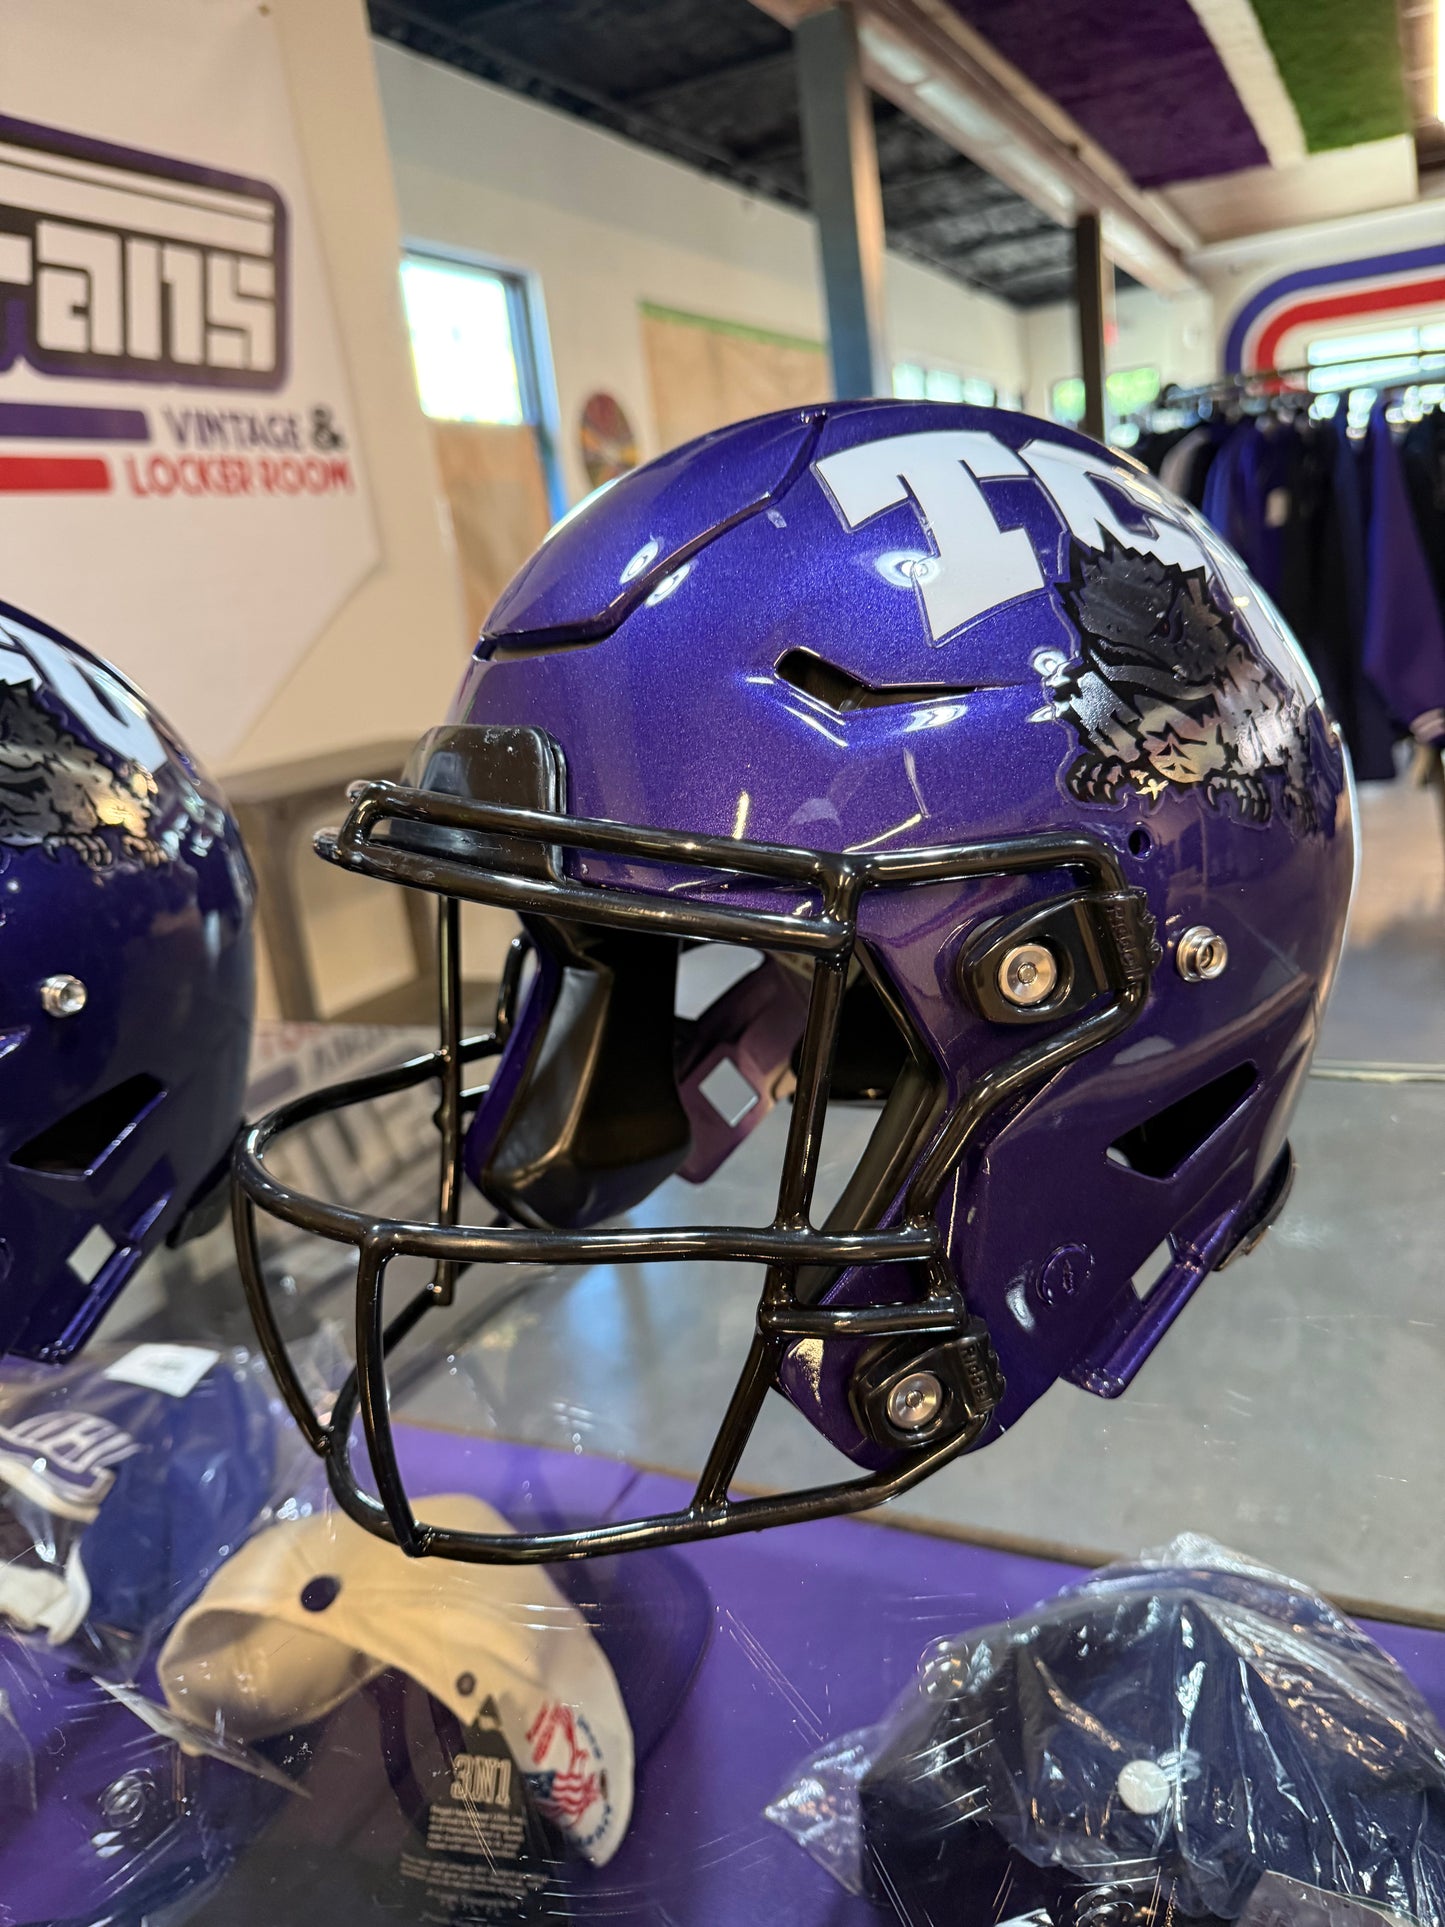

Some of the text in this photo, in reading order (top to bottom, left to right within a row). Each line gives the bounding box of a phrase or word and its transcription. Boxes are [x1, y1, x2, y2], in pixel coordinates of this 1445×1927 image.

[164, 404, 343, 450] VINTAGE &
[128, 456, 352, 496] LOCKER ROOM
